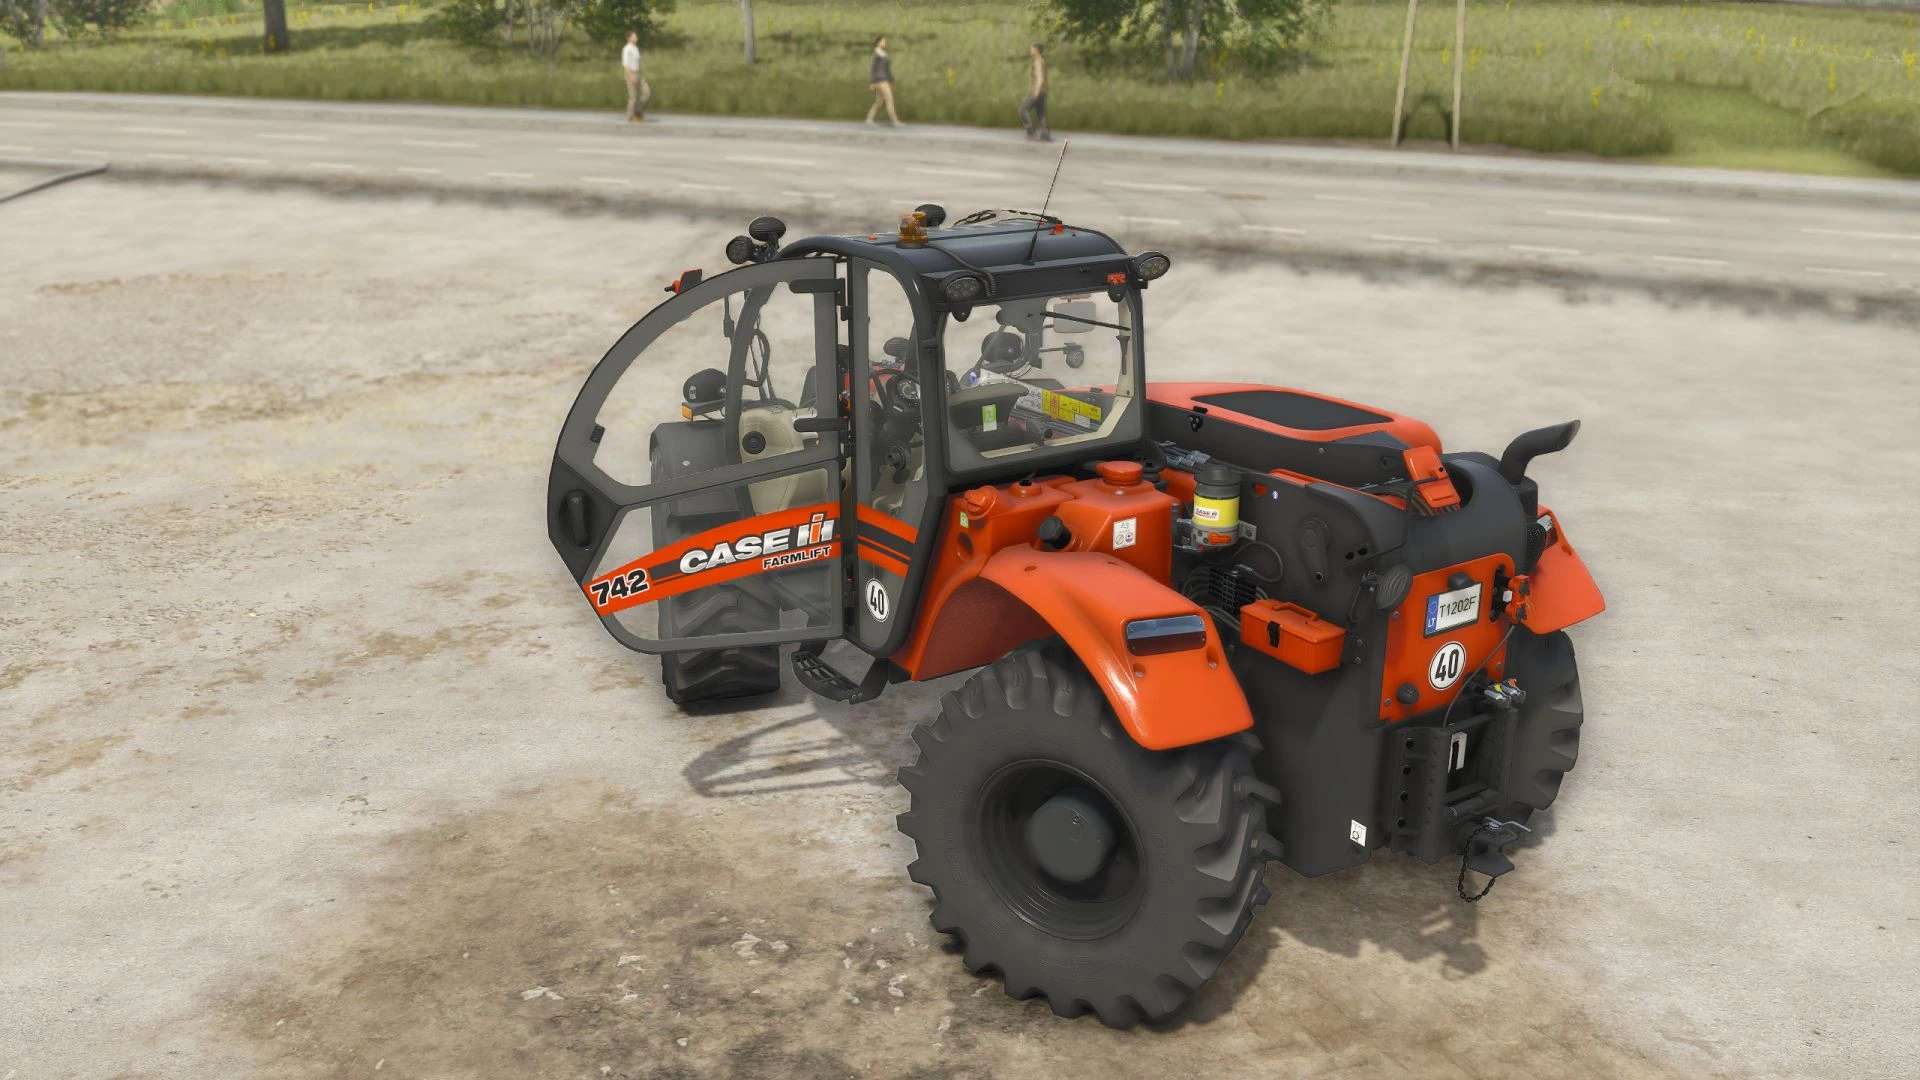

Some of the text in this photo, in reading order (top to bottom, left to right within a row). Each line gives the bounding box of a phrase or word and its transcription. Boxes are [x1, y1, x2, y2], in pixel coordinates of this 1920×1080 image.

[680, 530, 789, 573] CASE
[762, 545, 831, 570] FARMLIFT
[591, 569, 649, 606] 742
[870, 585, 885, 616] 40
[1440, 596, 1477, 617] T1202F
[1435, 648, 1460, 681] 40
